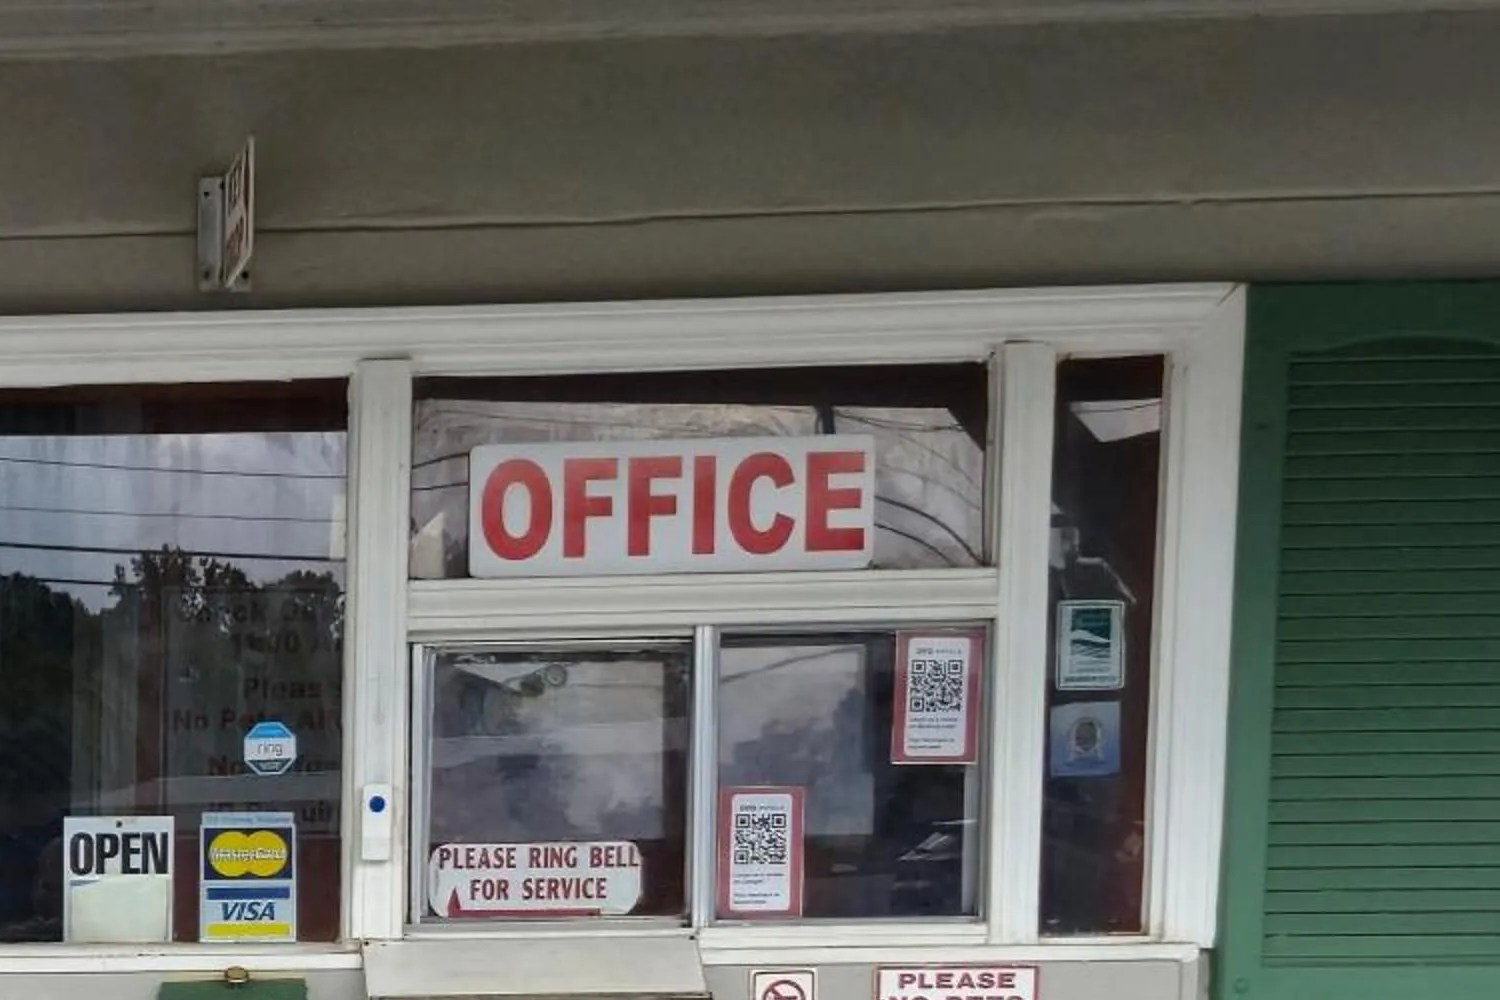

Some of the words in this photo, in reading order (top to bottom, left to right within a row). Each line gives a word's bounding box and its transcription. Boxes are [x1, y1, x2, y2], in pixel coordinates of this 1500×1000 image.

[481, 450, 866, 561] OFFICE
[257, 740, 284, 757] ring
[68, 831, 169, 877] OPEN
[438, 846, 517, 870] PLEASE
[528, 846, 578, 869] RING
[589, 845, 640, 868] BELL
[469, 878, 510, 901] FOR
[521, 876, 608, 900] SERVICE
[220, 901, 276, 922] VISA
[898, 971, 1017, 990] PLEASE
